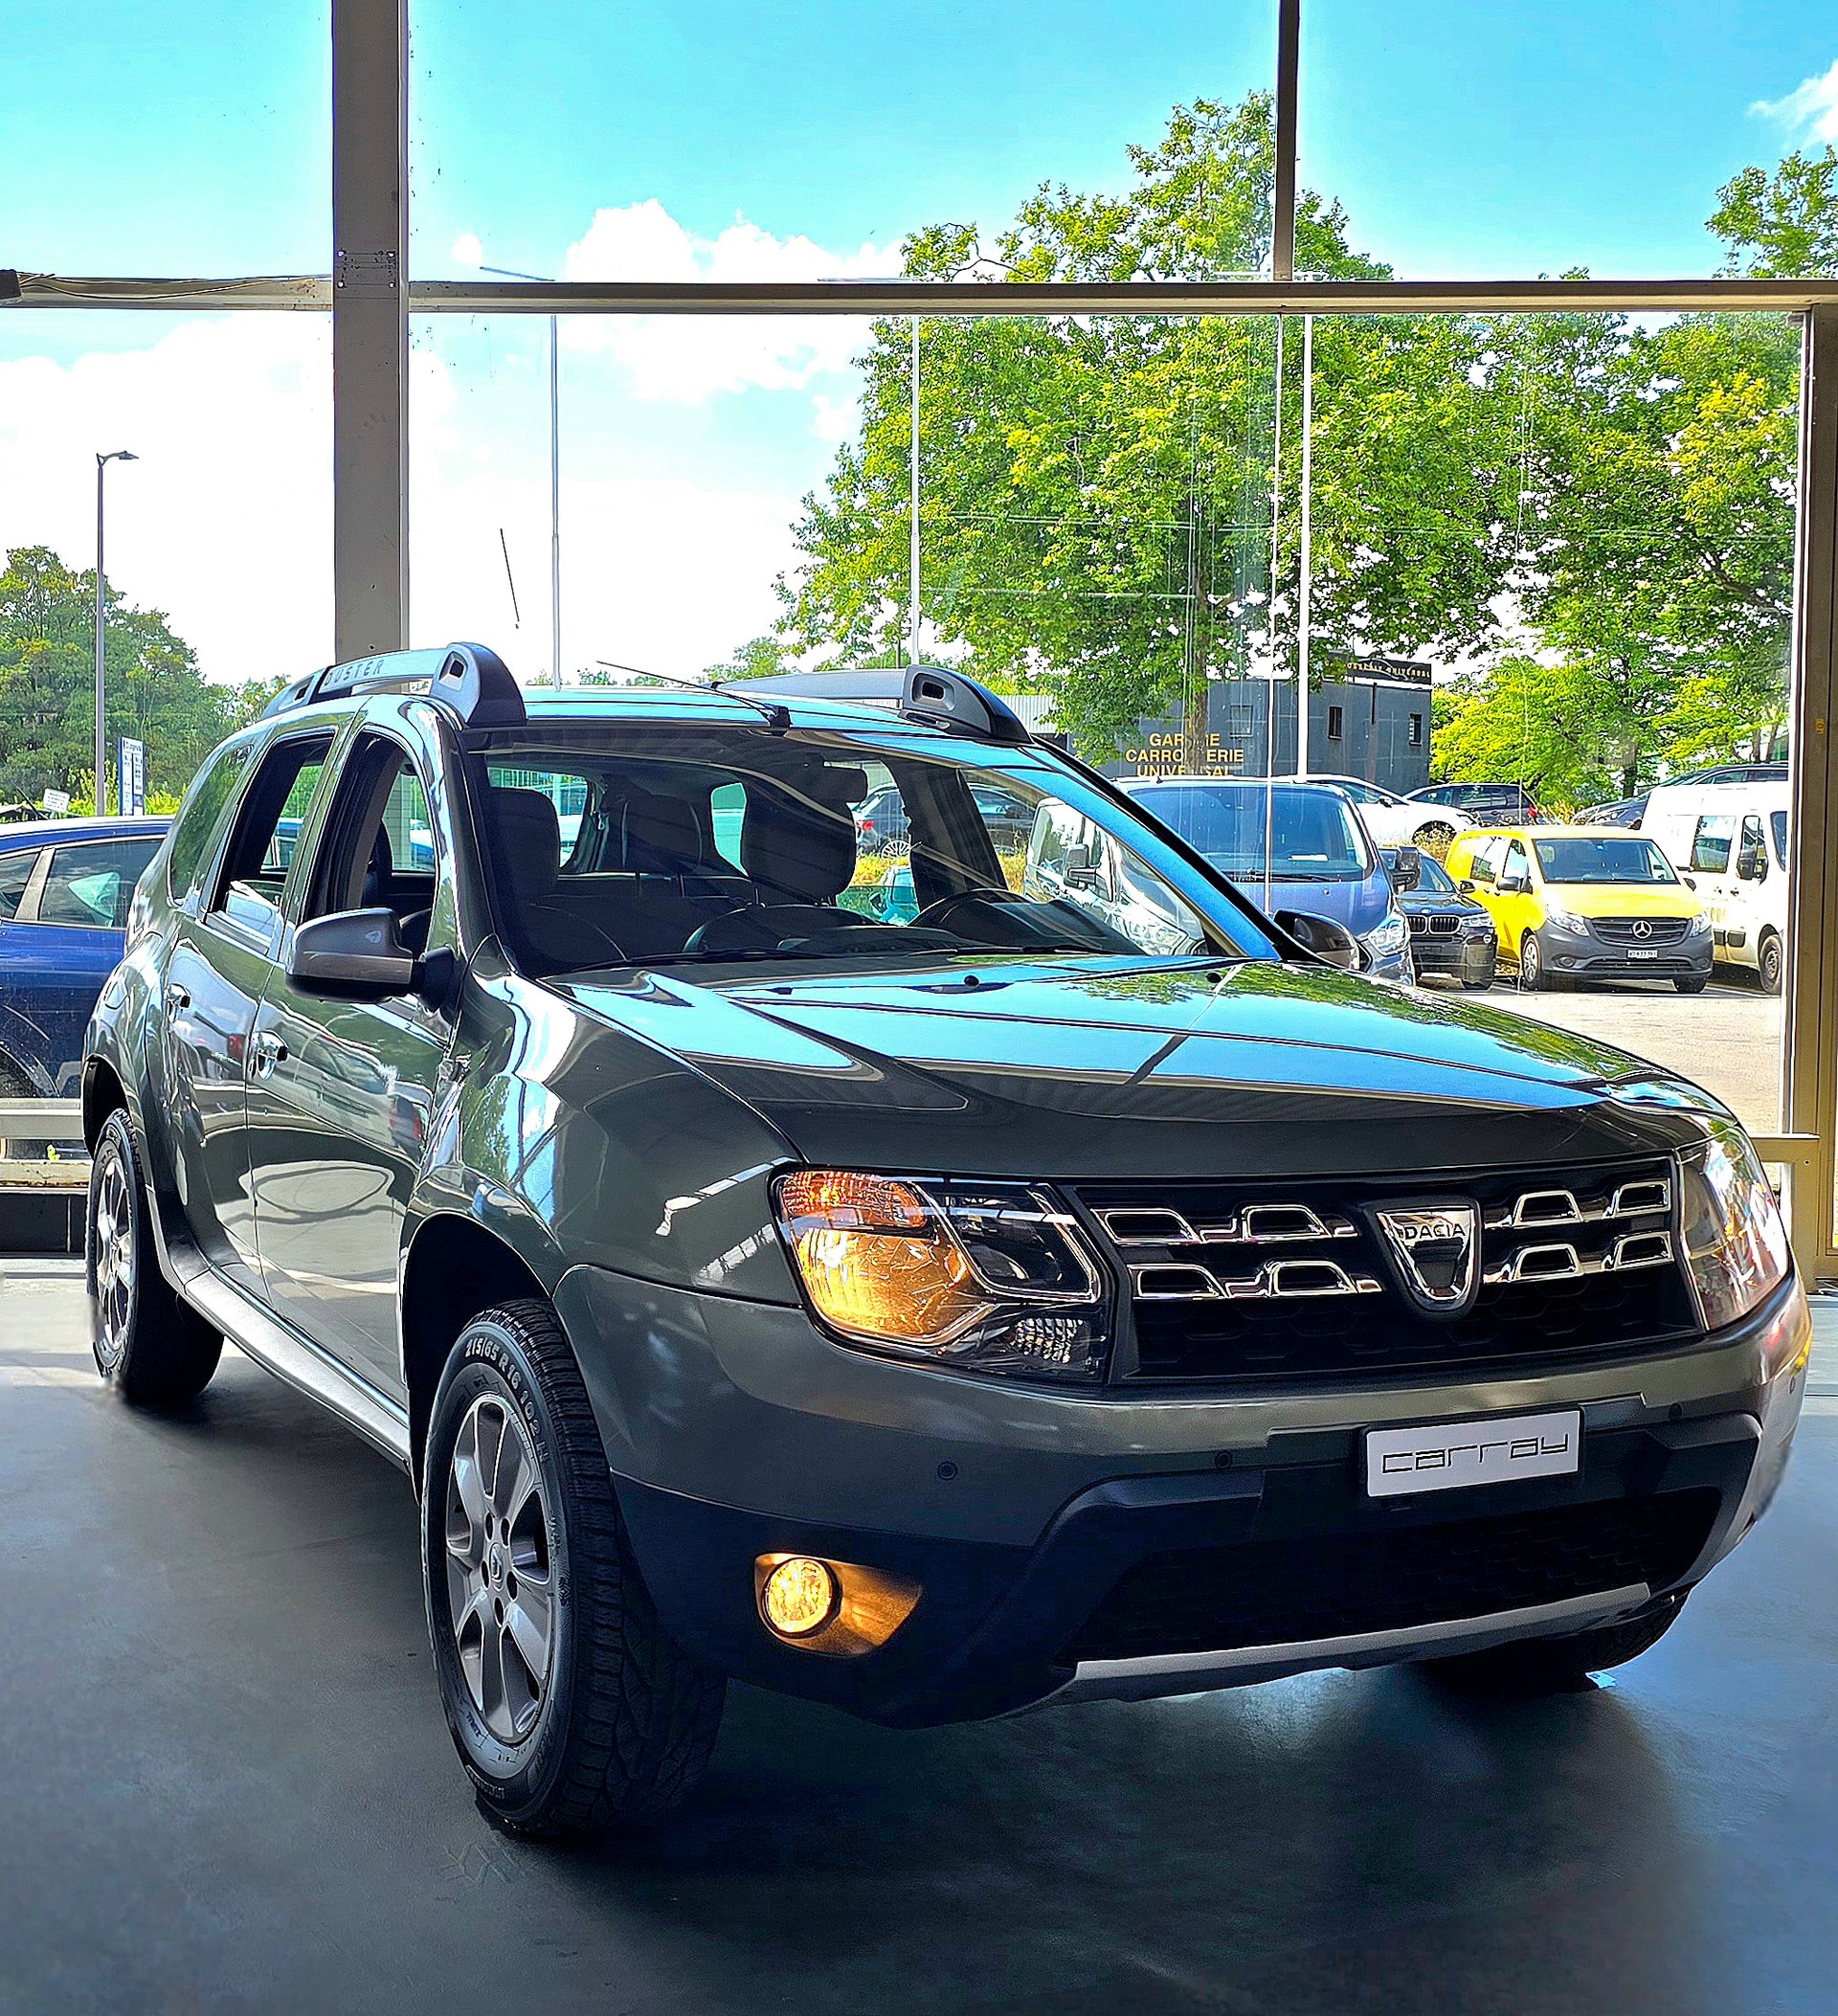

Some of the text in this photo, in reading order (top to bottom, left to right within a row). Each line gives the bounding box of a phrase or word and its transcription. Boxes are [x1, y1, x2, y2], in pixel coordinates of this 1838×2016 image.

[325, 659, 385, 686] DUSTER
[1149, 732, 1221, 747] GARE
[1125, 749, 1244, 763] CARROERIE
[1136, 764, 1229, 777] UNIVESAL
[1403, 1222, 1467, 1241] DACIA
[464, 1336, 501, 1361] 215/65
[1382, 1433, 1569, 1474] carray
